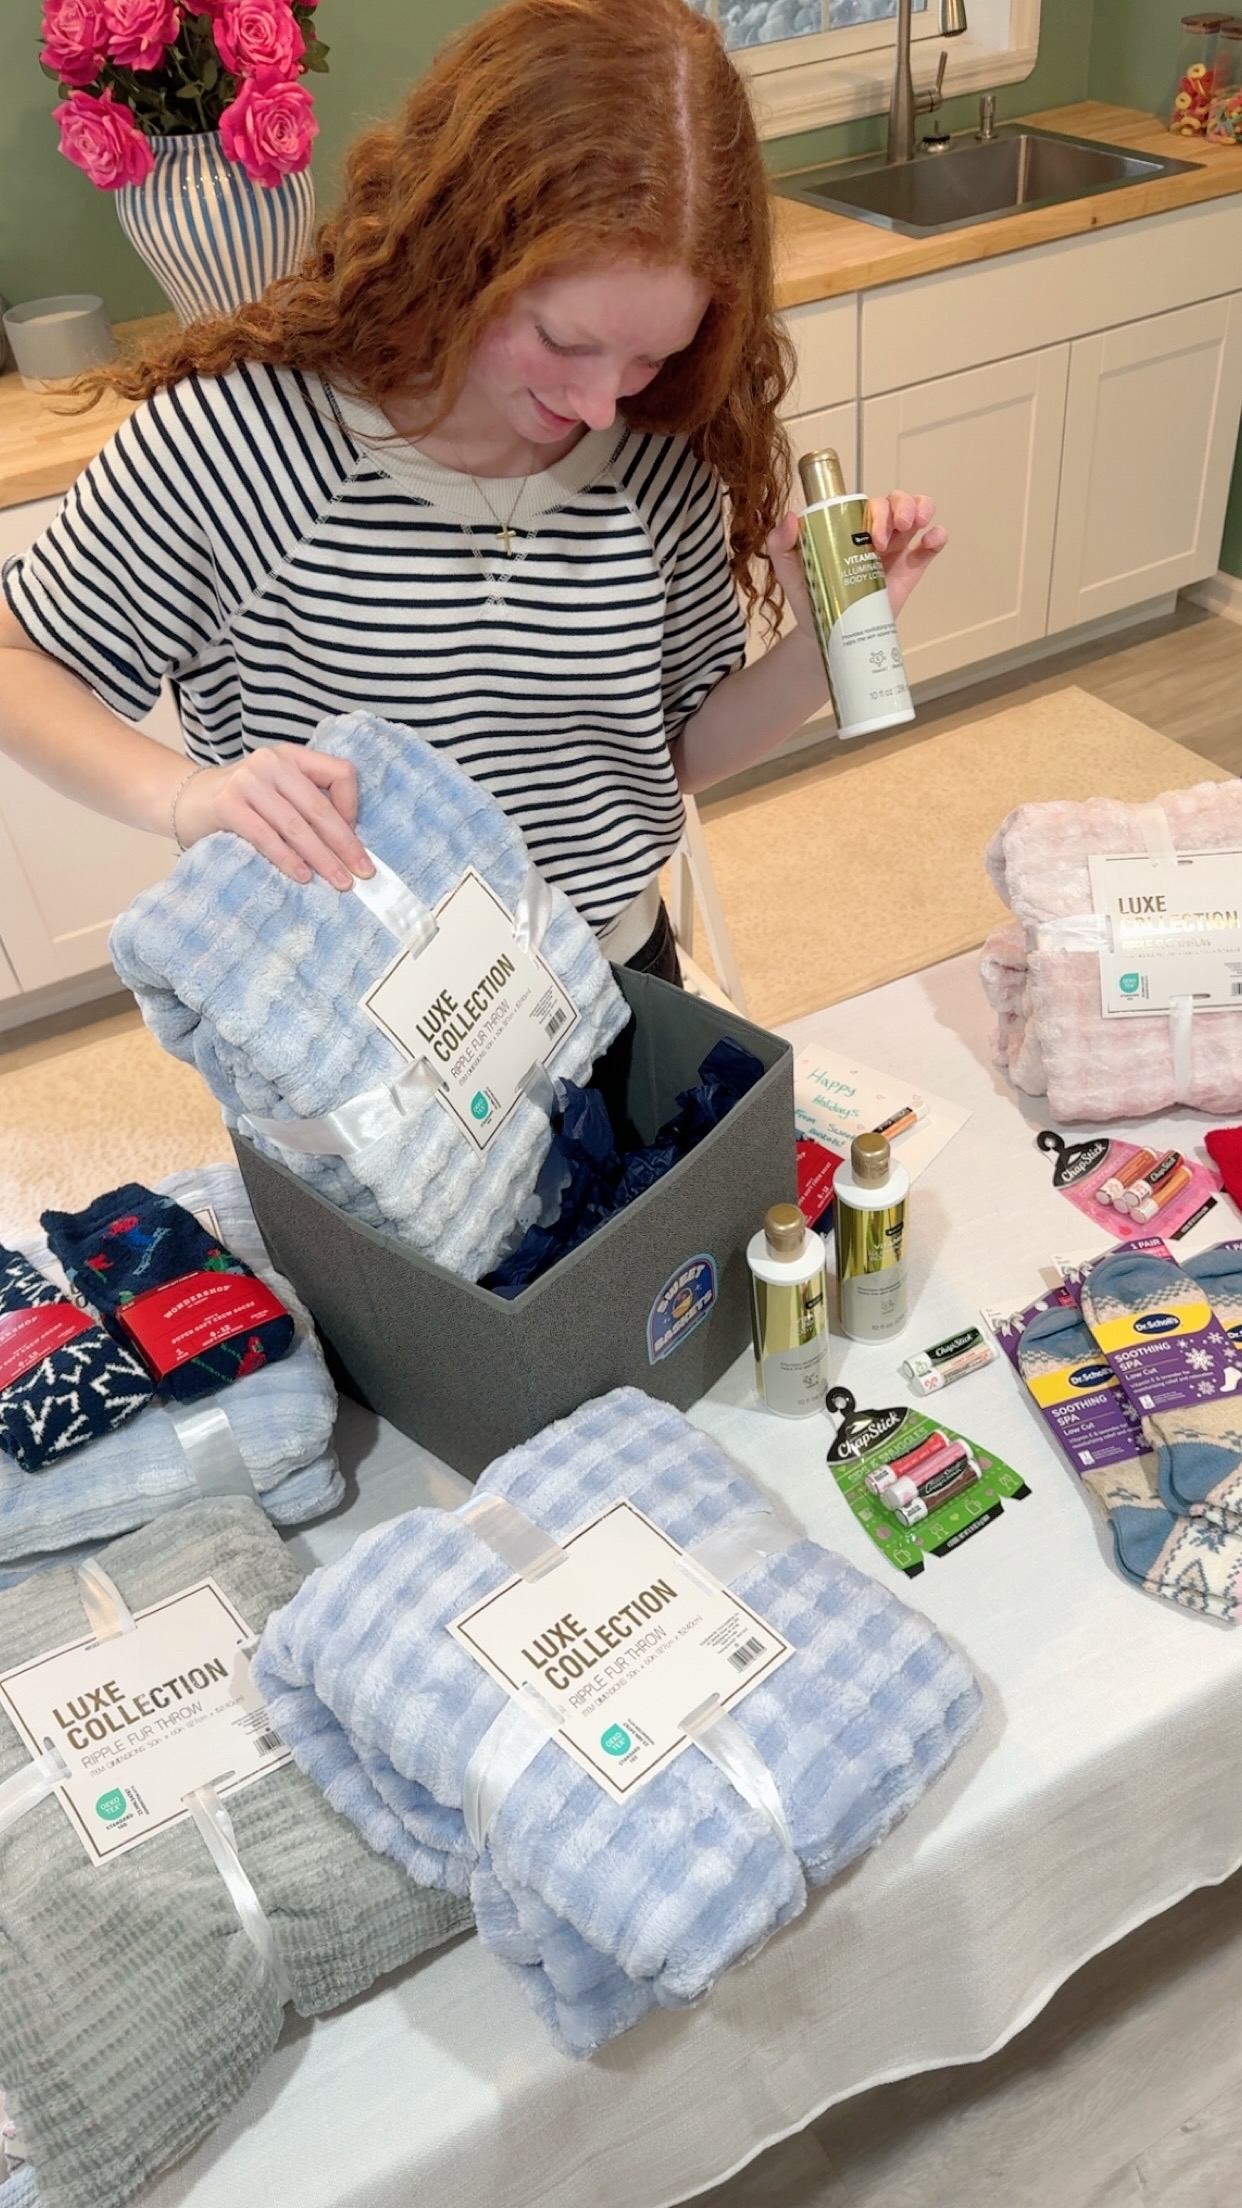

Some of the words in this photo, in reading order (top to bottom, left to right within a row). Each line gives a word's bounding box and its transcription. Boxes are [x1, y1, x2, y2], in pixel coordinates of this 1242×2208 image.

[1118, 895, 1167, 914] LUXE
[416, 989, 458, 1044] LUXE
[433, 953, 516, 1062] COLLECTION
[450, 1045, 474, 1080] RIPPLE
[471, 1029, 488, 1052] FUR
[484, 998, 511, 1035] THROW
[807, 1067, 857, 1097] Happy
[1061, 1143, 1106, 1182] ChapStick
[1138, 1237, 1162, 1250] PAIR
[164, 1284, 233, 1319] WONDERSHOP
[656, 1264, 706, 1313] SWEET
[171, 1330, 193, 1345] SUPER
[193, 1320, 212, 1335] SOFT
[211, 1311, 233, 1326] CREW
[233, 1301, 256, 1316] SOCKS
[654, 1289, 713, 1352] BASKETS
[935, 1333, 974, 1358] ChapStick
[1114, 1341, 1171, 1363] SOOTHING
[1119, 1359, 1143, 1372] SPA
[1125, 1371, 1141, 1381] Low
[1142, 1366, 1158, 1377] Cut
[1051, 1394, 1108, 1418] SOOTHING
[1056, 1413, 1080, 1427] SPA
[837, 1411, 900, 1458] ChapStick
[878, 1427, 929, 1465] SNUGGLES
[1063, 1426, 1080, 1436] Low
[1080, 1422, 1095, 1431] Cut
[521, 1613, 587, 1669] LUXE
[544, 1578, 678, 1690] COLLECTION
[568, 1671, 608, 1709] RIPPLE
[604, 1656, 630, 1679] FUR
[624, 1625, 667, 1664] THROW
[52, 1680, 126, 1730] LUXE
[66, 1658, 229, 1751] COLLECTION
[81, 1736, 126, 1769] RIPPLE
[127, 1725, 156, 1751] FUR
[153, 1701, 203, 1735] THROW
[100, 1796, 121, 1812] OEKO
[105, 1813, 135, 1831] STANDARD
